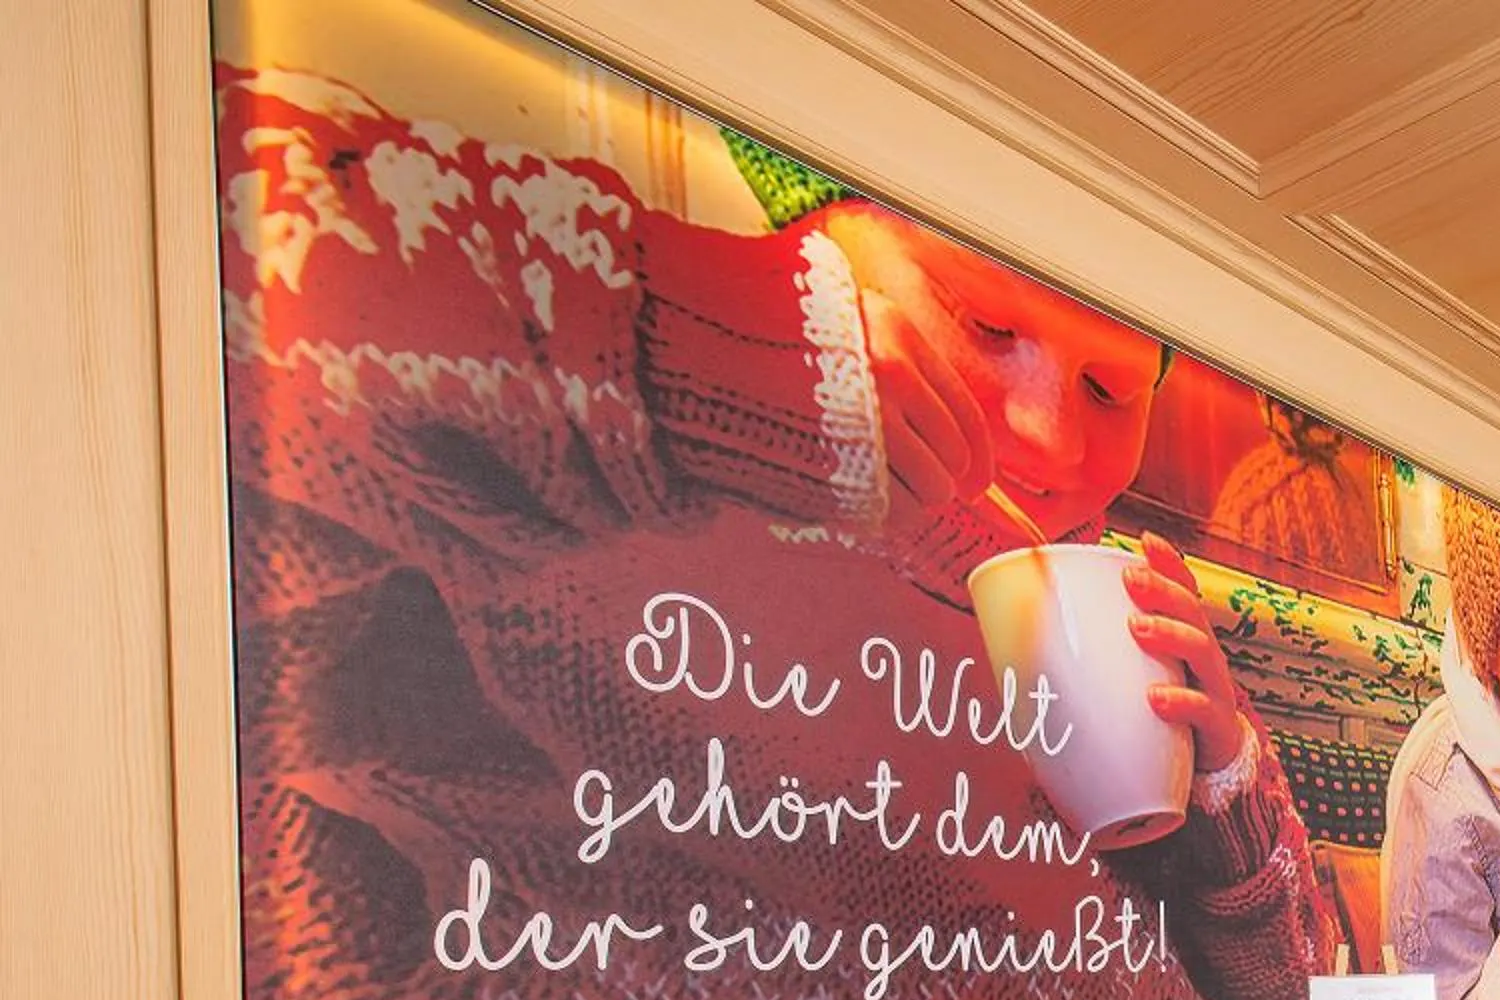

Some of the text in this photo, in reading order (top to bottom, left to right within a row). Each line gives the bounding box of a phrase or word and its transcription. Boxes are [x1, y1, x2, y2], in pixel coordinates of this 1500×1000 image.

[625, 592, 1073, 757] Die Welt
[573, 737, 1100, 877] gehört dem,
[433, 857, 664, 971] der
[683, 899, 843, 971] sie
